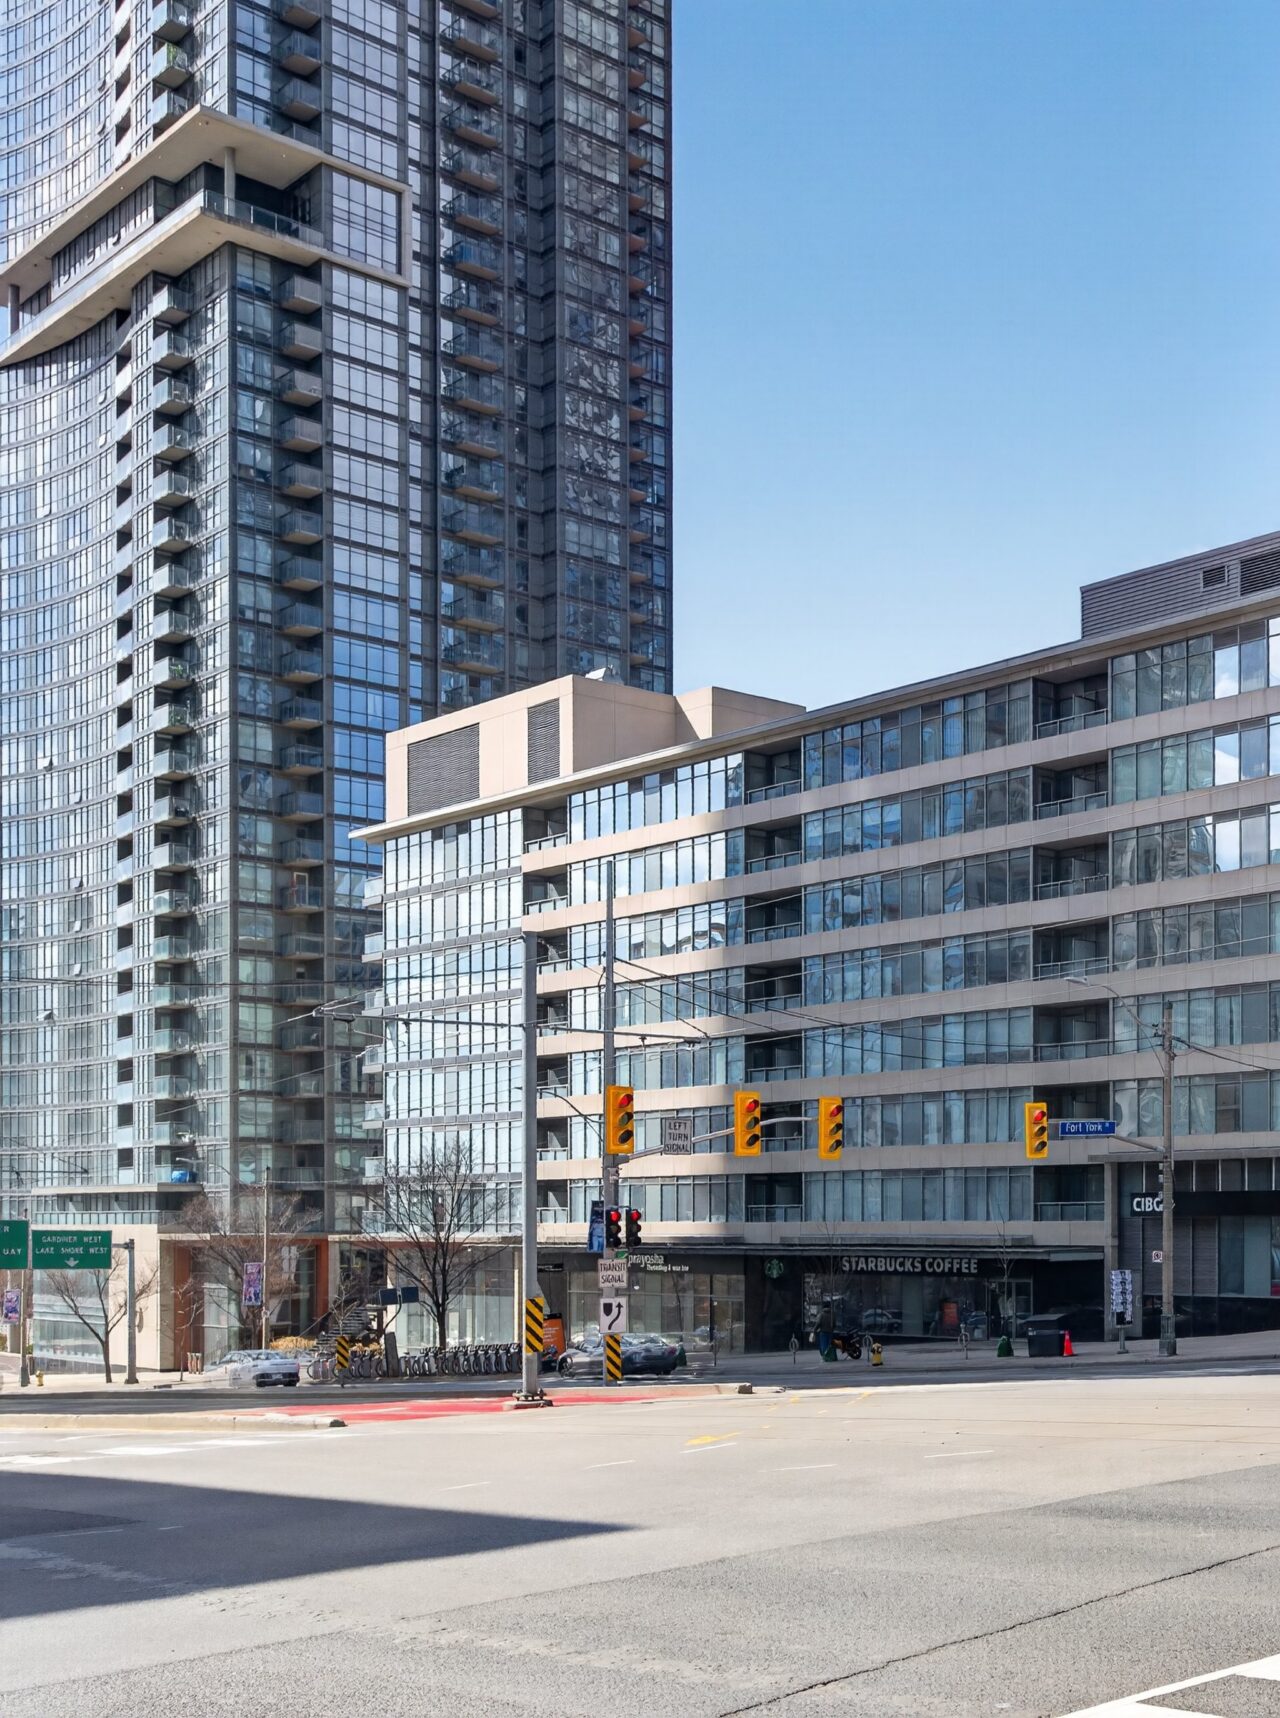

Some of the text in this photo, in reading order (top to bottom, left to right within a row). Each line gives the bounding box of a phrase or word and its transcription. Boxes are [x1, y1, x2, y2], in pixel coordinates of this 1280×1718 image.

[668, 1122, 687, 1130] LEFT
[1065, 1122, 1082, 1132] Fort
[1085, 1122, 1103, 1132] York
[668, 1133, 689, 1141] TURN
[665, 1144, 690, 1152] SIGNAL
[41, 1235, 102, 1243] GARDINER WEST
[35, 1246, 108, 1254] LAKE SHORE WEST
[600, 1262, 626, 1272] TRANSIT
[842, 1256, 978, 1273] STARBUCKS COFFEE
[601, 1275, 625, 1283] SIGNAL
